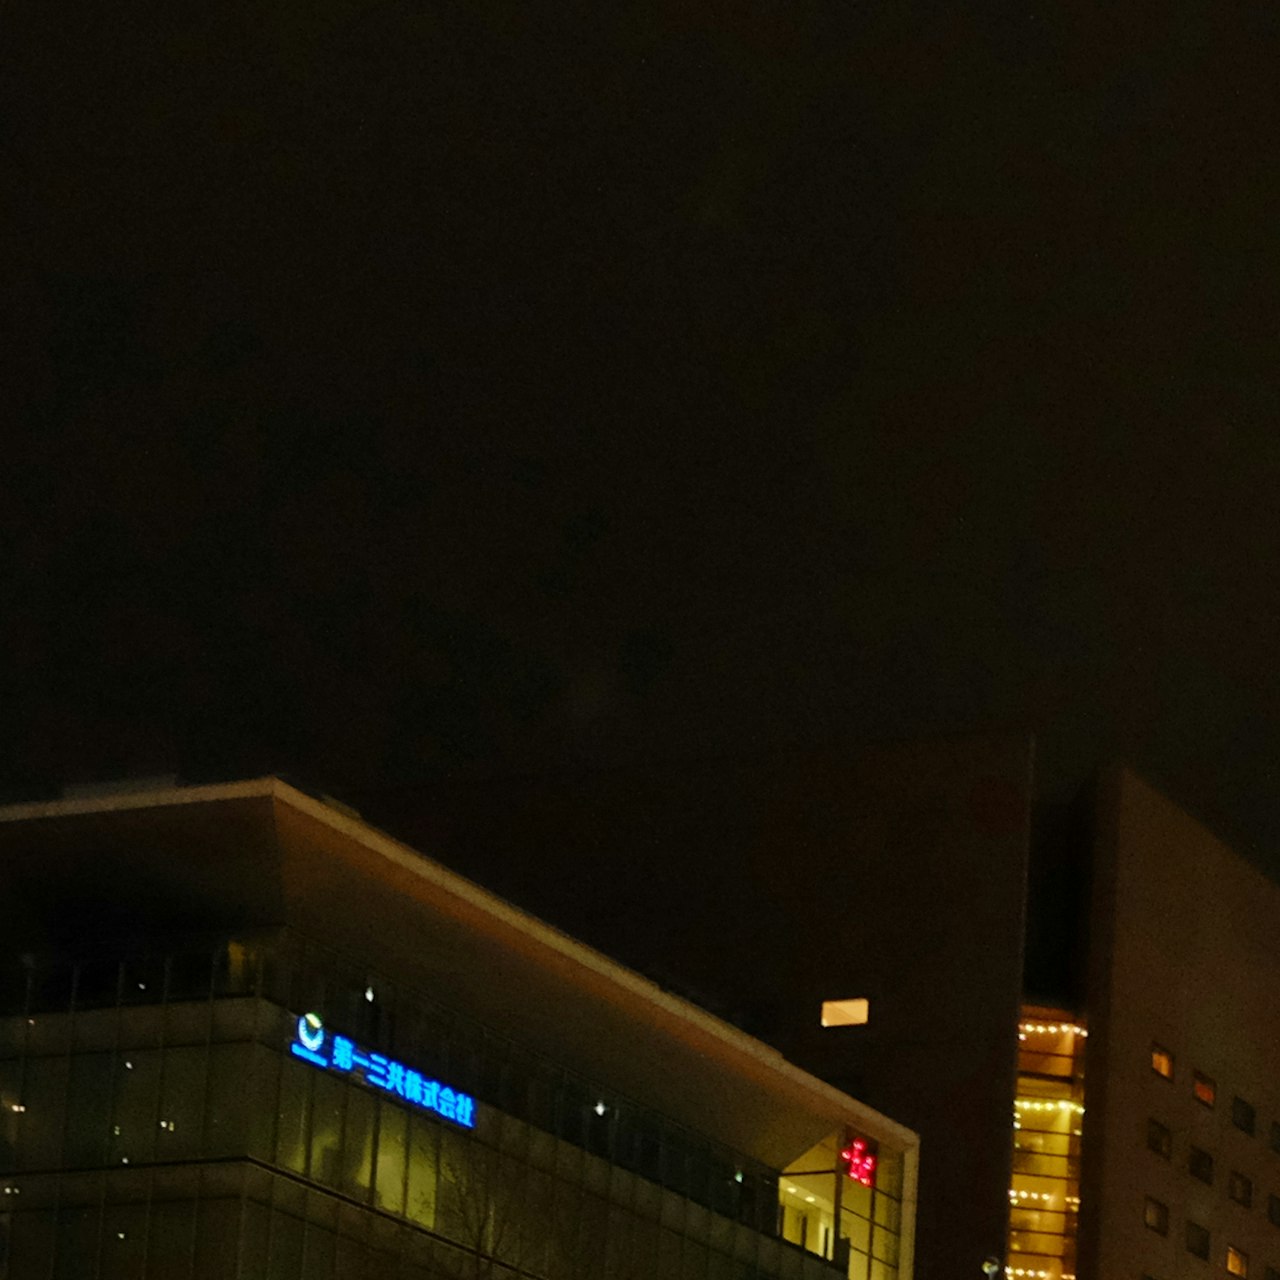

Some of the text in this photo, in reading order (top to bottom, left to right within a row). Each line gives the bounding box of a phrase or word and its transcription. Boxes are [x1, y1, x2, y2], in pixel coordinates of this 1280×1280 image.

[332, 1034, 475, 1129] 第一三共株式会社
